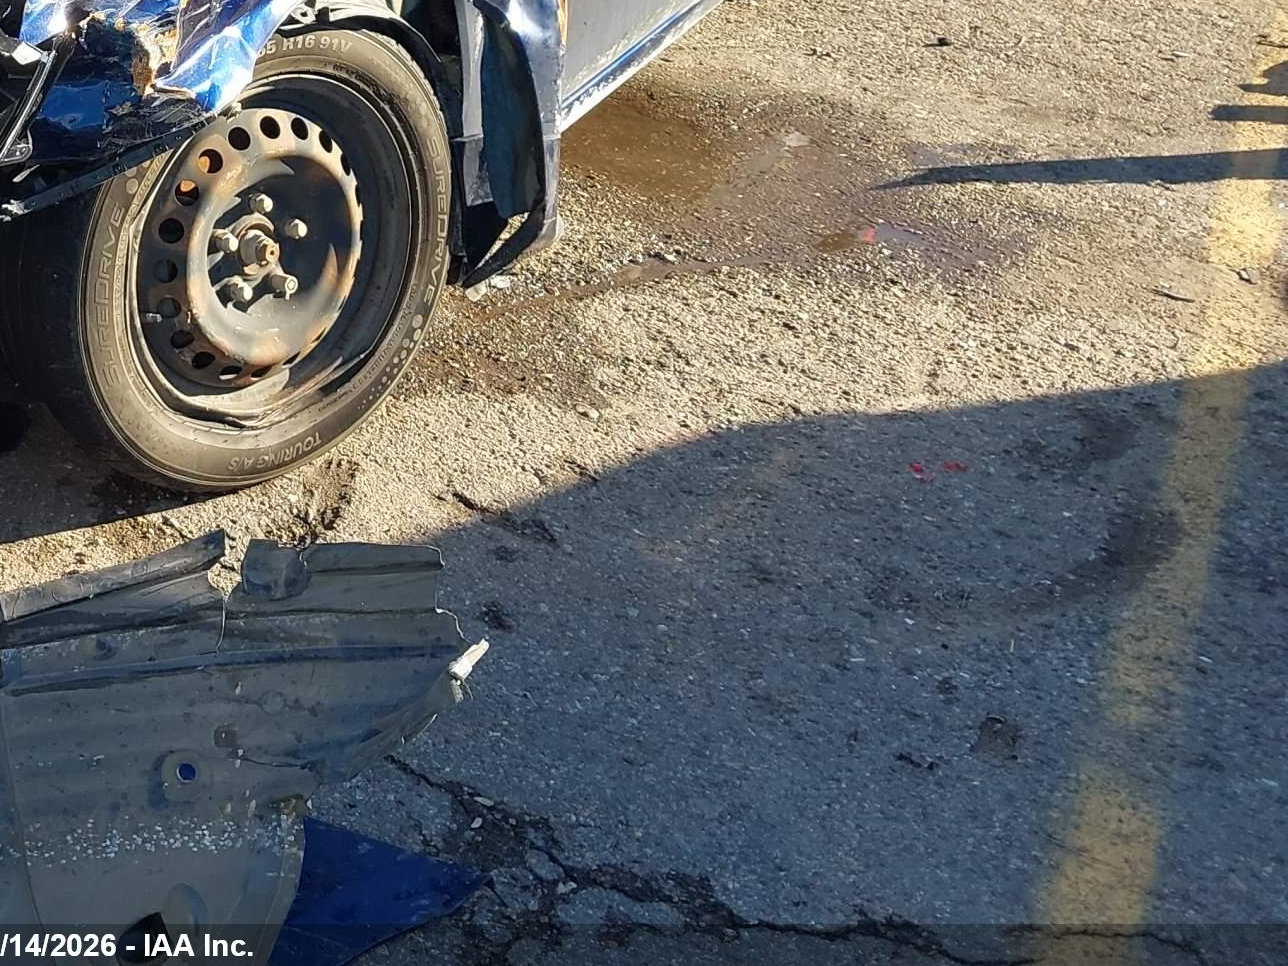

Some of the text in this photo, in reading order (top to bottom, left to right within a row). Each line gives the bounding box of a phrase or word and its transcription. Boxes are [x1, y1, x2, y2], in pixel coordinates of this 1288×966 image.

[320, 36, 353, 53] 91V
[228, 431, 322, 472] TOURING A/S
